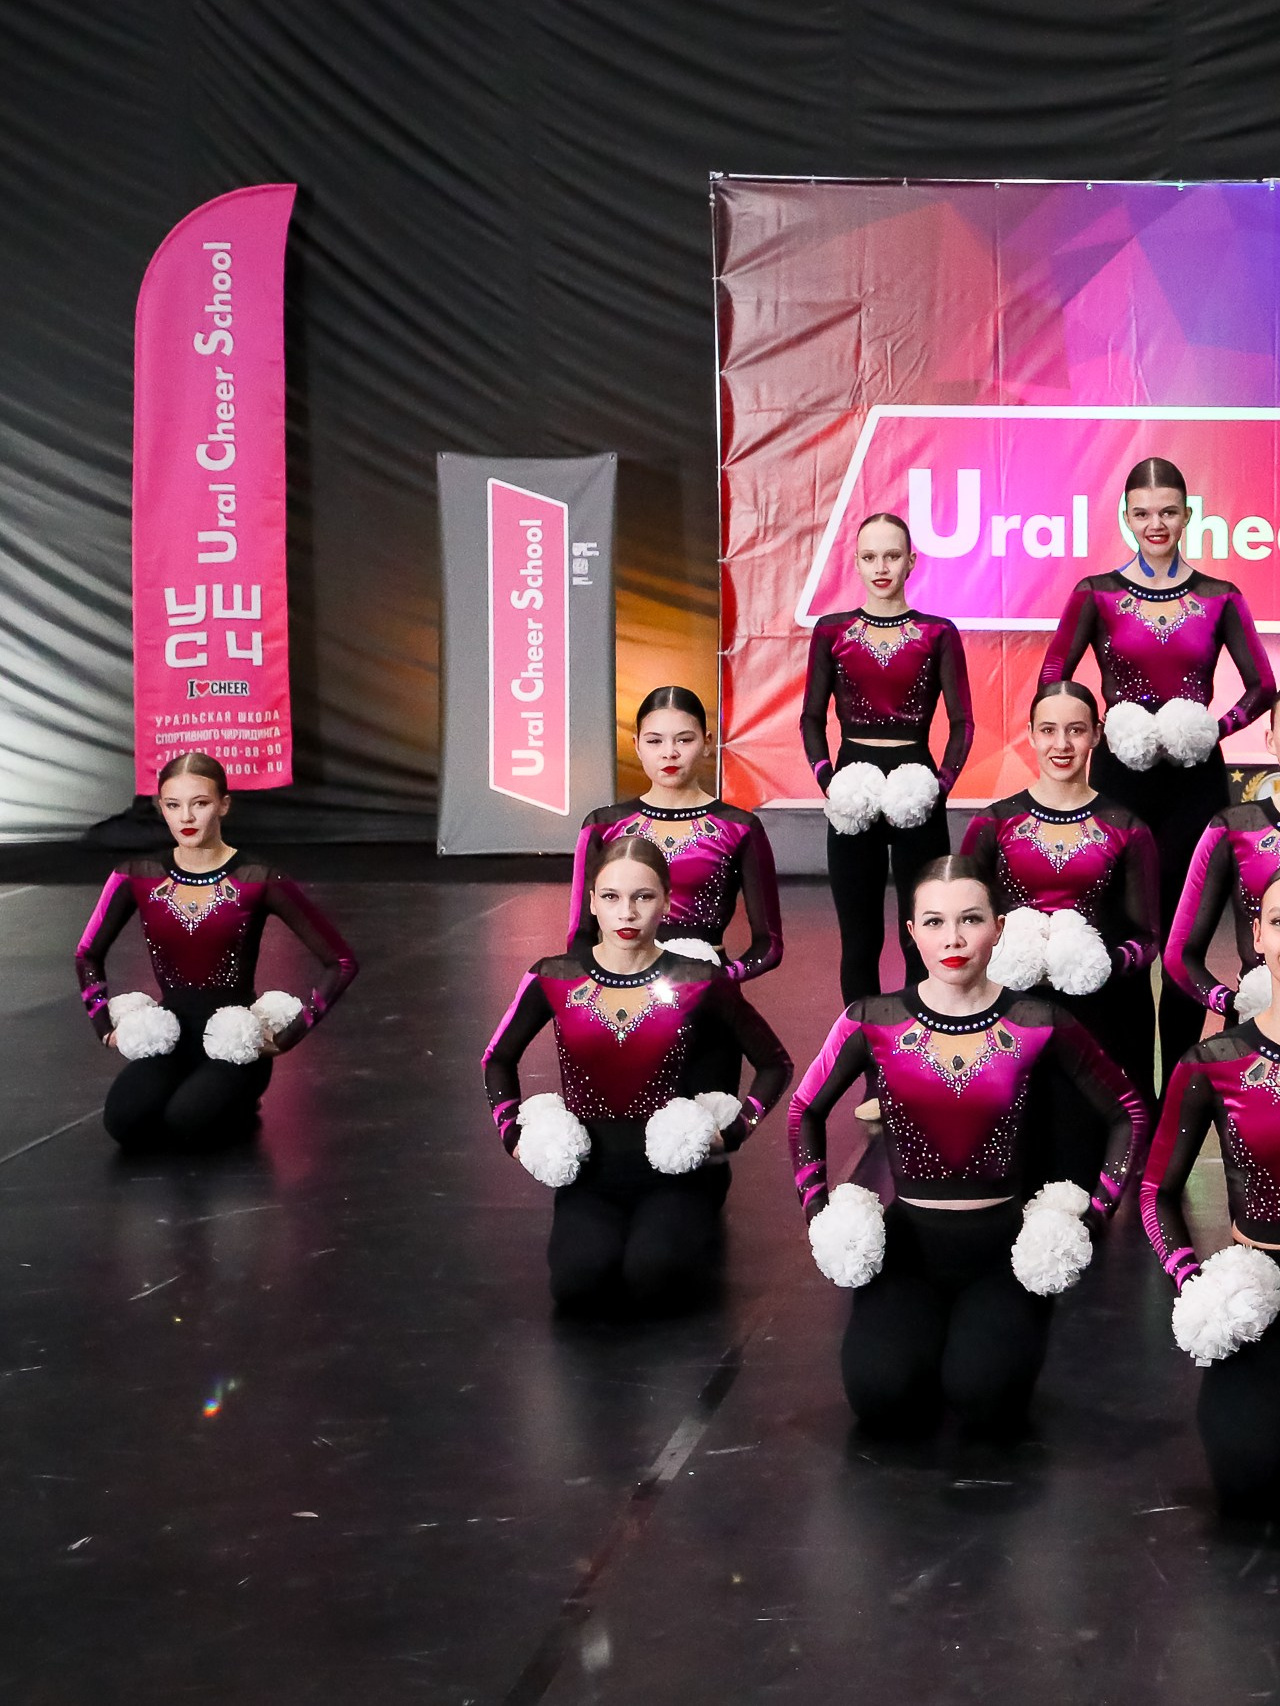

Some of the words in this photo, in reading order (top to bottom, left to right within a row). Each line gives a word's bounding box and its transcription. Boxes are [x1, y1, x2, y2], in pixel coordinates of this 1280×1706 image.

[193, 241, 234, 356] School
[196, 367, 237, 472] Cheer
[197, 482, 238, 564] Ural
[907, 467, 1089, 560] Ural
[510, 519, 543, 611] School
[211, 681, 248, 695] CHEER
[511, 617, 545, 703] Cheer
[155, 711, 232, 728] УРАЛЬСКАЯ
[237, 709, 281, 723] ШКОЛА
[155, 728, 220, 745] СПОРТИВНОГО
[221, 726, 281, 741] ЧИРЛИДИНГА
[511, 712, 545, 776] Ural
